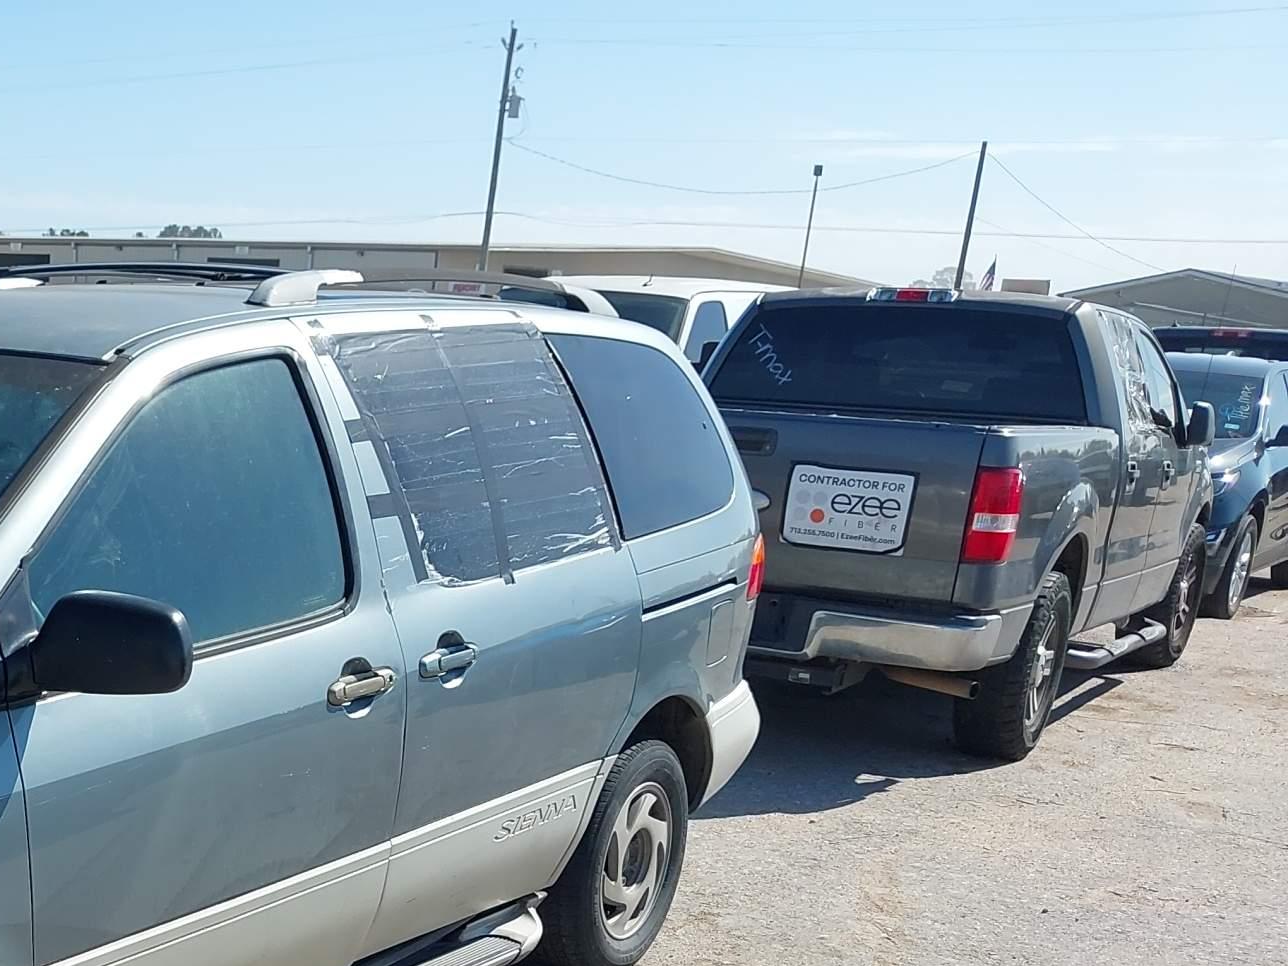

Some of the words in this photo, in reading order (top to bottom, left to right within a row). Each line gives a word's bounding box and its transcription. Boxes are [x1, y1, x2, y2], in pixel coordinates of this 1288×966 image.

[798, 473, 880, 490] CONTRACTOR
[881, 482, 906, 493] FOR
[830, 493, 901, 519] ezee
[828, 517, 897, 533] FIBER
[493, 795, 577, 842] SIENNA
